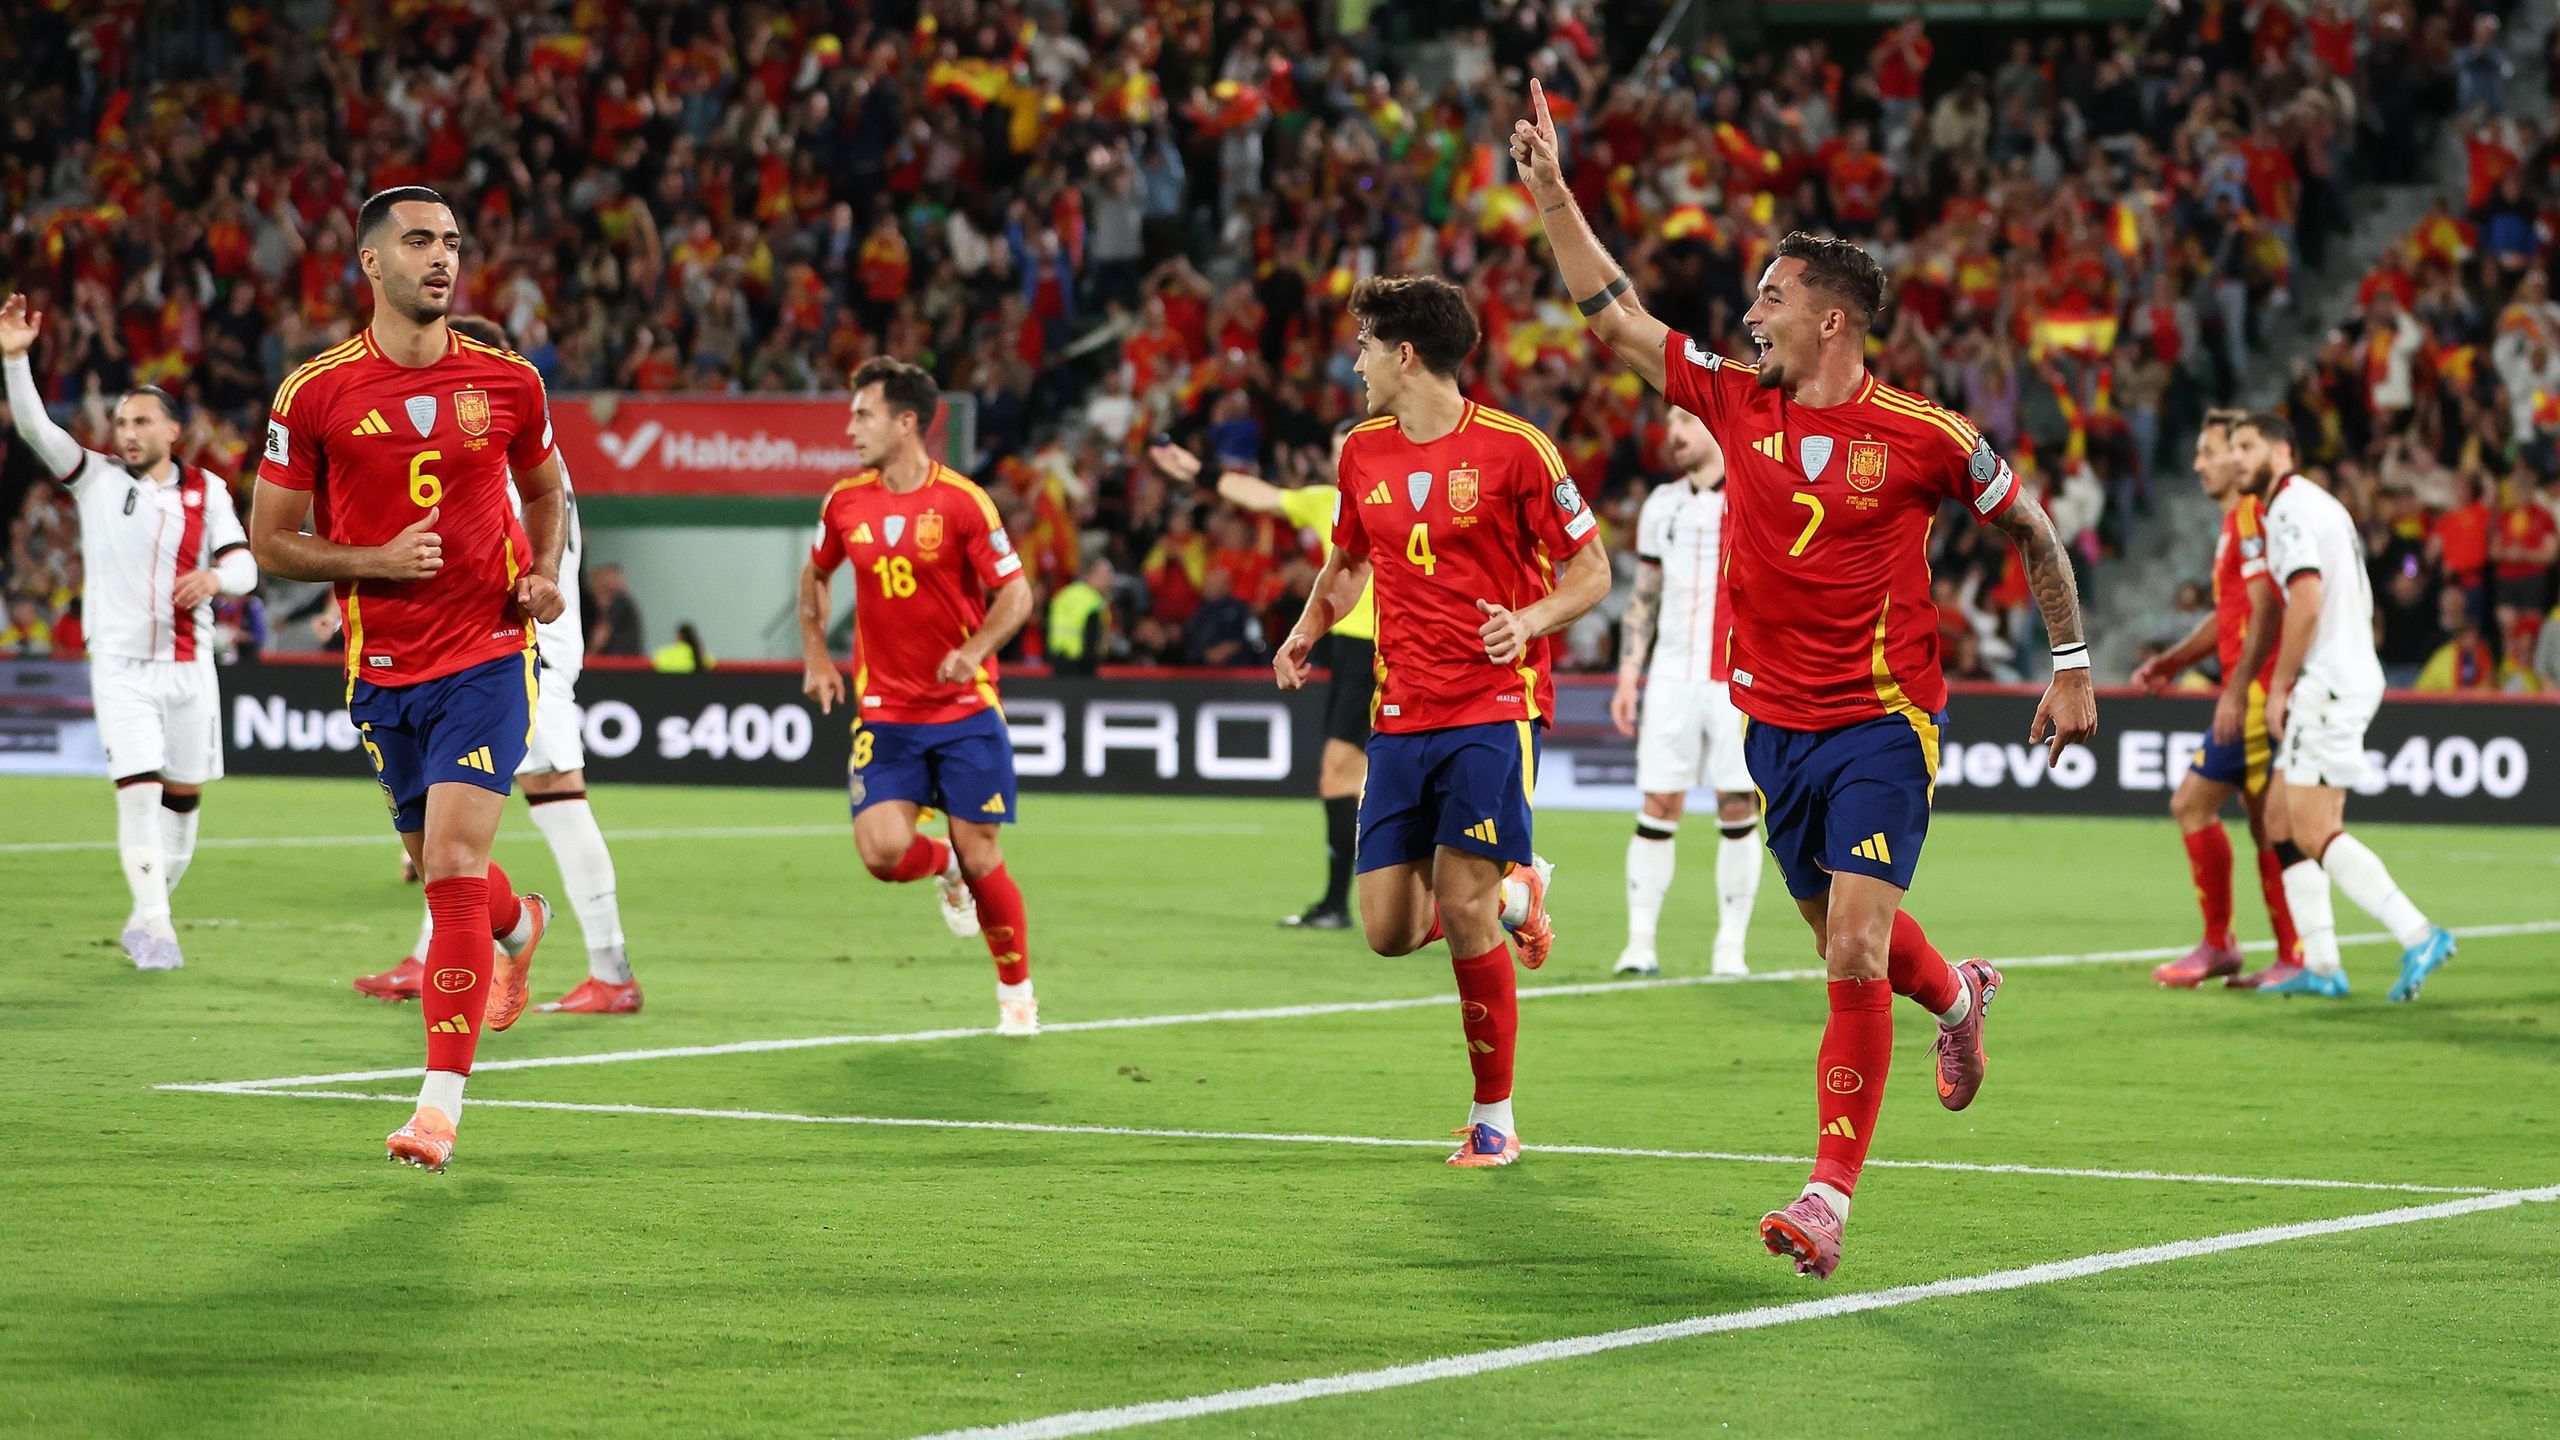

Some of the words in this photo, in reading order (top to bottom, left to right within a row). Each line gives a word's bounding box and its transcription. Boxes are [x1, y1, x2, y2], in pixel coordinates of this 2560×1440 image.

[661, 430, 798, 470] Halcón
[409, 450, 442, 507] 6
[1406, 523, 1437, 576] 4
[1789, 491, 1825, 557] 7
[872, 555, 918, 599] 18
[234, 693, 363, 753] Nue
[657, 703, 814, 761] s400
[1937, 742, 2098, 790] uevo
